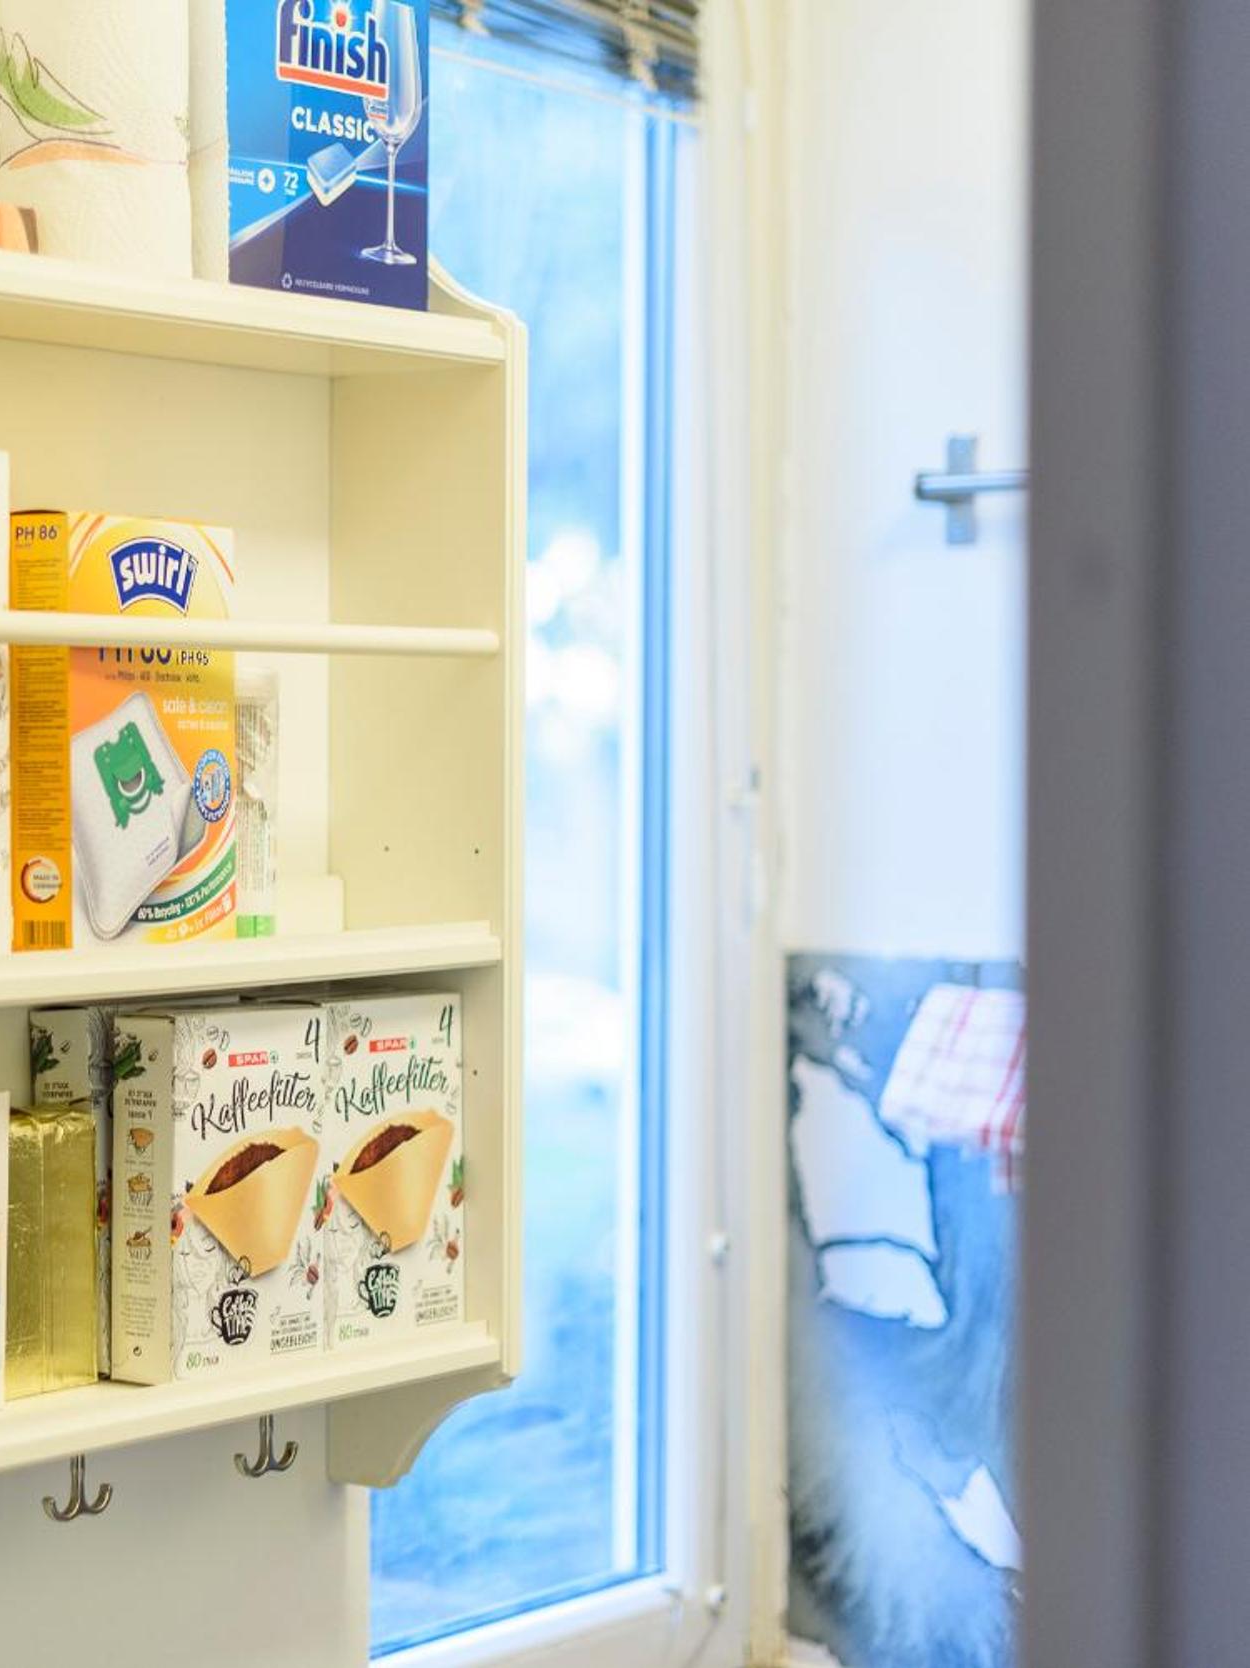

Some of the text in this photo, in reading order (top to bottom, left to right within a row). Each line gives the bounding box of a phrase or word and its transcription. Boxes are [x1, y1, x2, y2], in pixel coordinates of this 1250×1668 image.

[278, 0, 386, 84] finish
[291, 106, 375, 143] CLASSIC
[283, 170, 299, 190] 72
[15, 524, 58, 541] PH 86
[119, 543, 189, 597] swirl
[304, 1017, 321, 1065] 4
[375, 1038, 408, 1052] SPAR
[439, 1003, 454, 1048] 4
[235, 1051, 269, 1066] SPAR
[191, 1069, 318, 1141] Kaffeefilter
[335, 1054, 450, 1123] Kaffeefilter
[185, 1351, 202, 1370] 80
